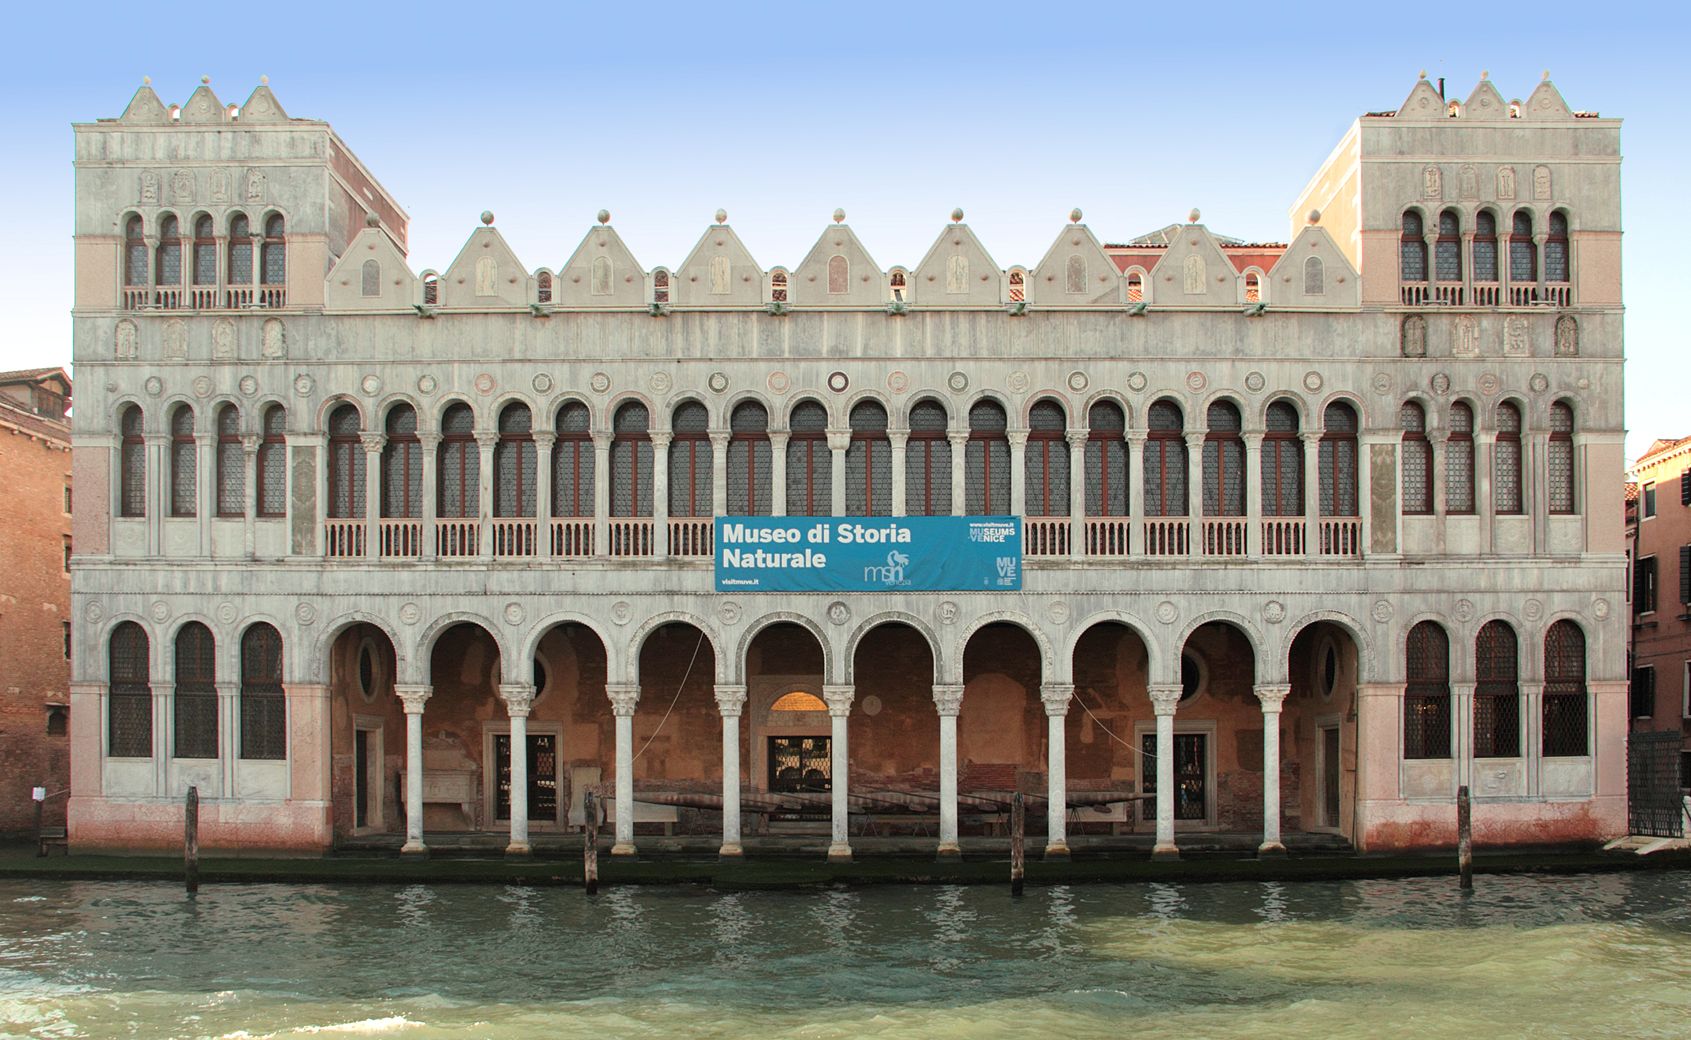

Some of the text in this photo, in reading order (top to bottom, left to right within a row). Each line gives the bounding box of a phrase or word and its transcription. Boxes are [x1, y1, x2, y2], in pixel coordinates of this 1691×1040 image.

[723, 523, 911, 543] Museo di Storia
[970, 528, 1015, 536] MUSEUMS
[723, 548, 826, 568] Naturale
[996, 557, 1016, 567] MU
[997, 566, 1016, 577] VE
